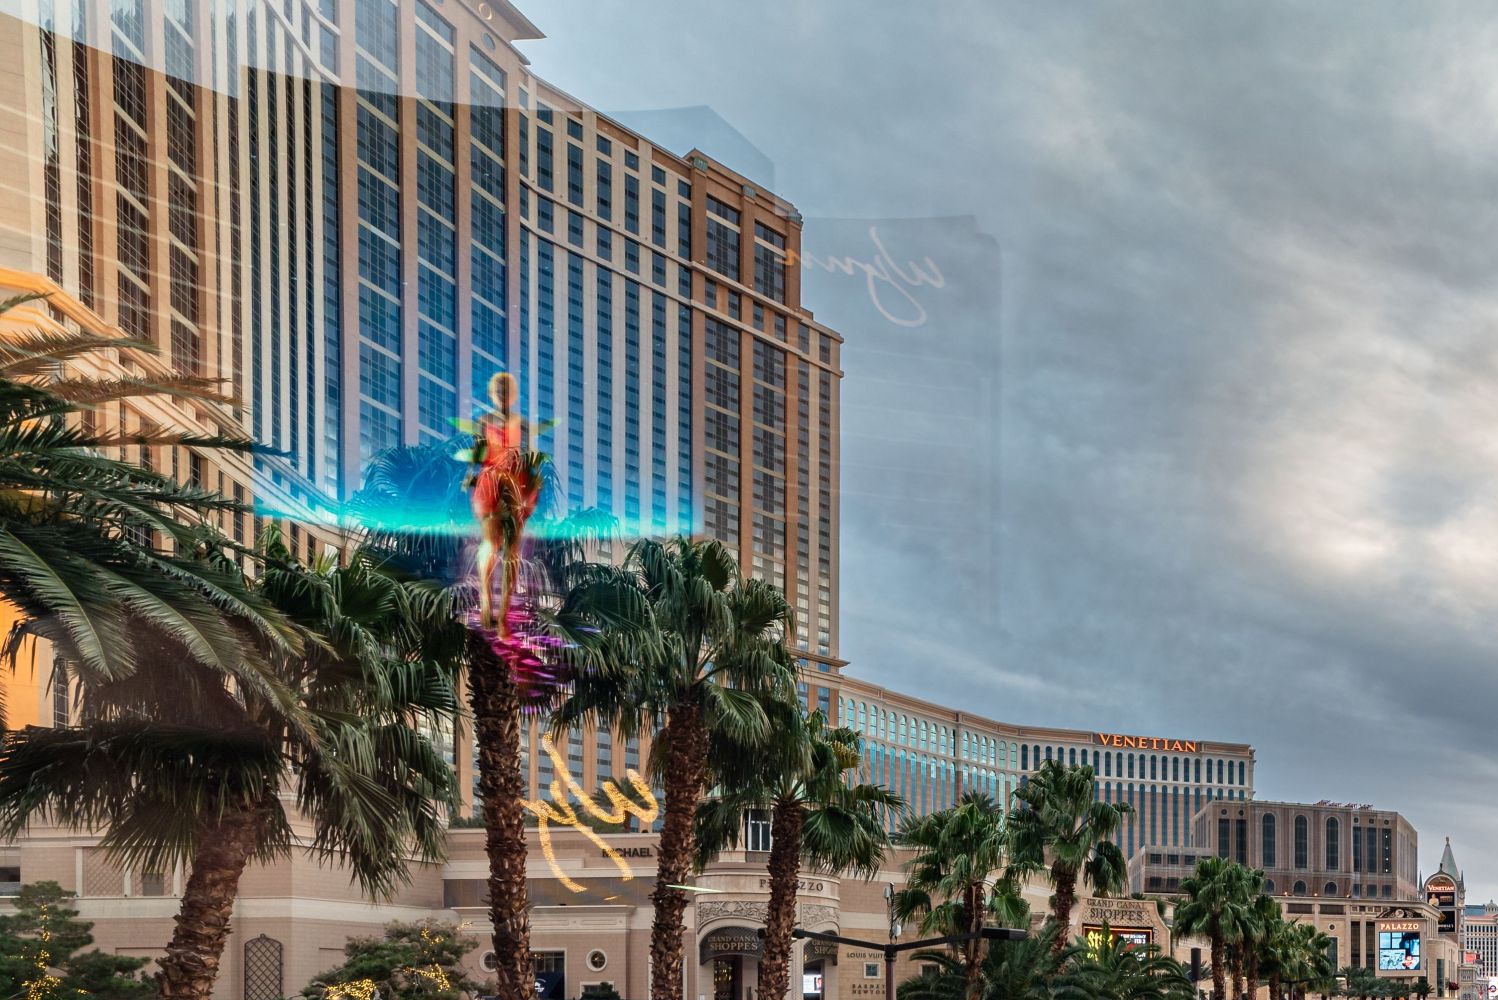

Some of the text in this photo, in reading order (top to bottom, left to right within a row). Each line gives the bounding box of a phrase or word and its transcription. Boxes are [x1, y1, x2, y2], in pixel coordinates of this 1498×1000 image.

[1098, 733, 1196, 753] VENETIAN
[759, 878, 824, 892] PZZO
[1090, 908, 1143, 920] SHOPPES
[710, 943, 758, 951] SHOPPES
